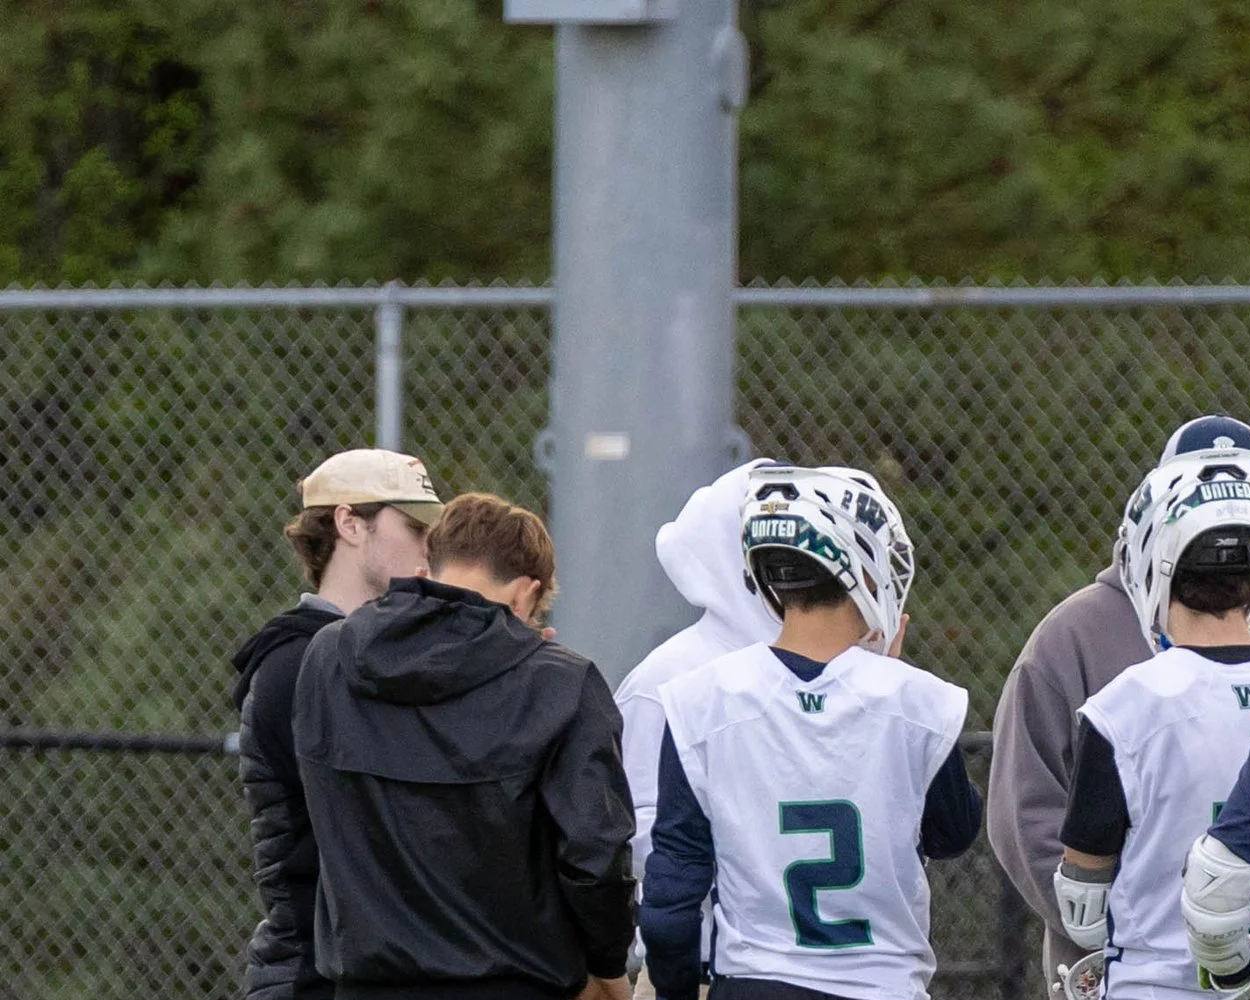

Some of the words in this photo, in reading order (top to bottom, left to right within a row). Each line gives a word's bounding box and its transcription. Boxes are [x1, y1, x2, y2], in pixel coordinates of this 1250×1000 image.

[752, 519, 796, 538] UNITED
[796, 689, 828, 714] W
[777, 799, 876, 950] 2
